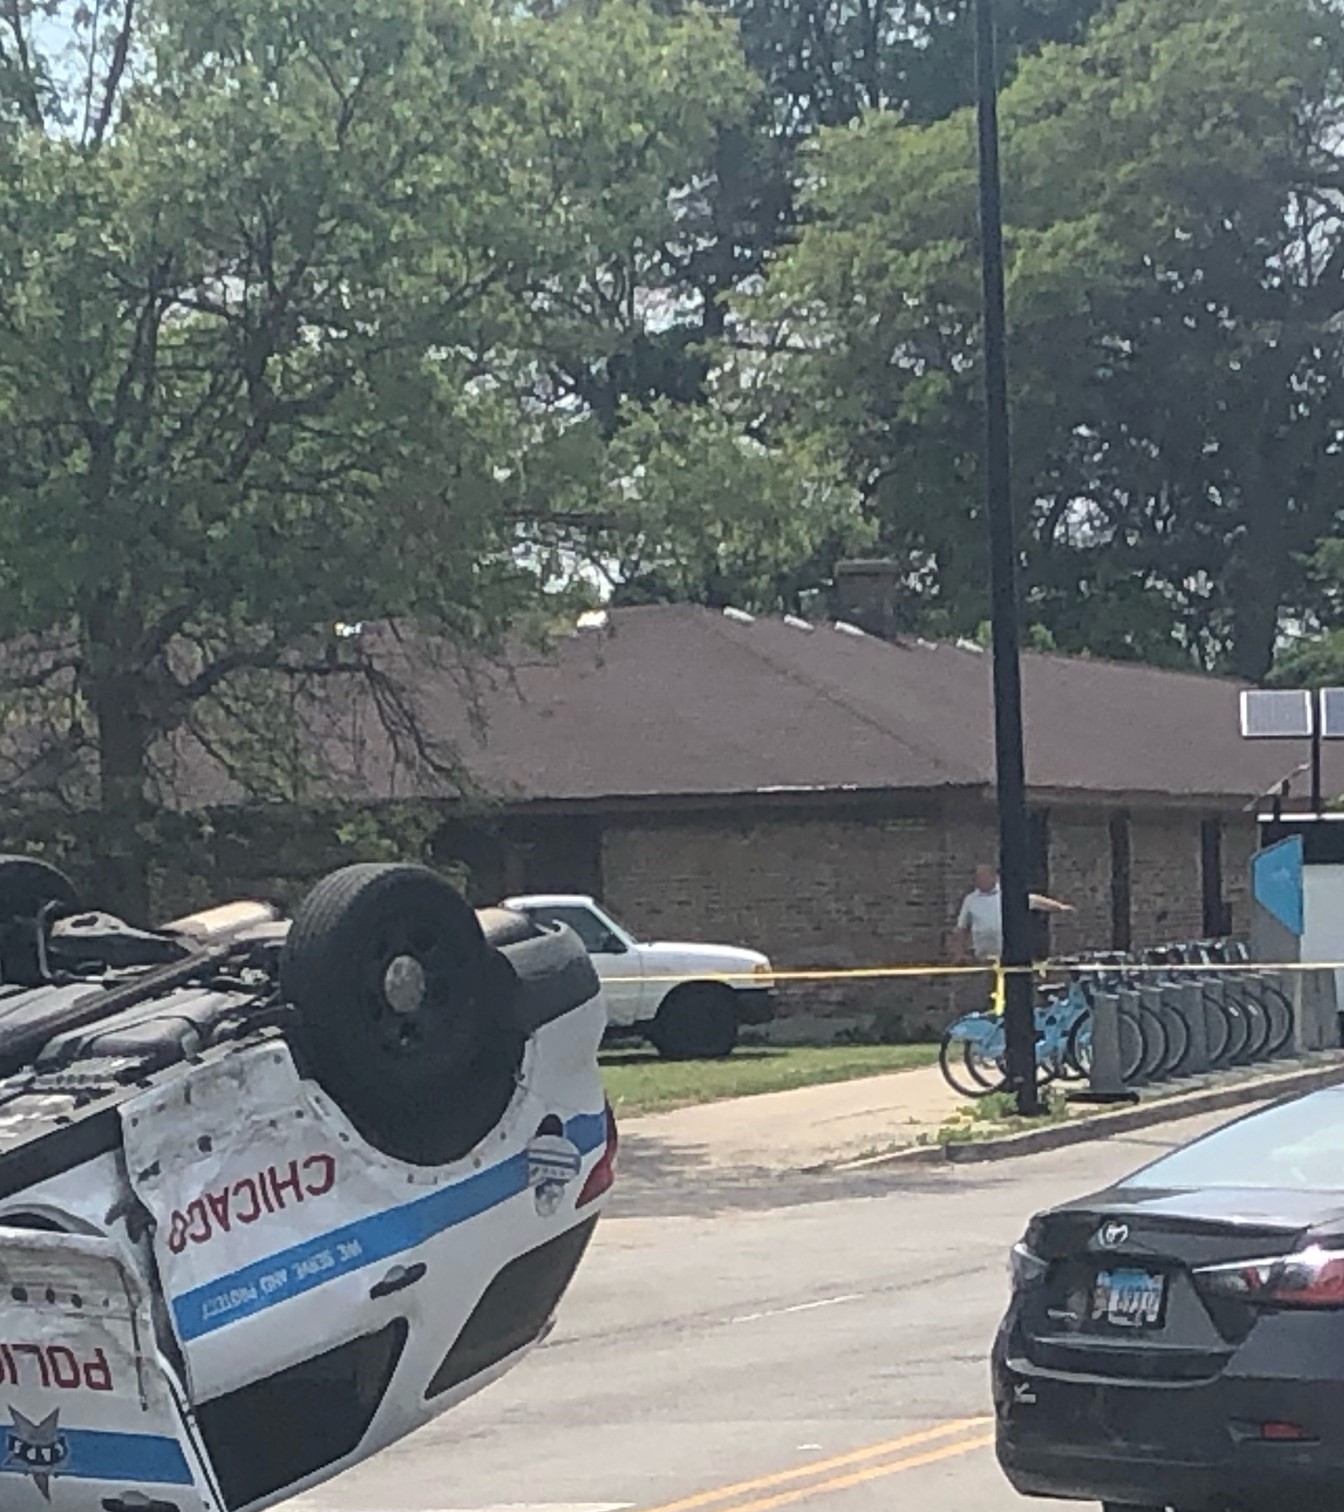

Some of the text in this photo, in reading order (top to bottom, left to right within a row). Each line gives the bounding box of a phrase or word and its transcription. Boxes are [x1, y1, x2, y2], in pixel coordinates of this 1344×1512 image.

[168, 1153, 337, 1254] CHICAGO
[336, 1239, 363, 1262] WE
[292, 1250, 335, 1280] SERVE
[259, 1268, 288, 1294] AND
